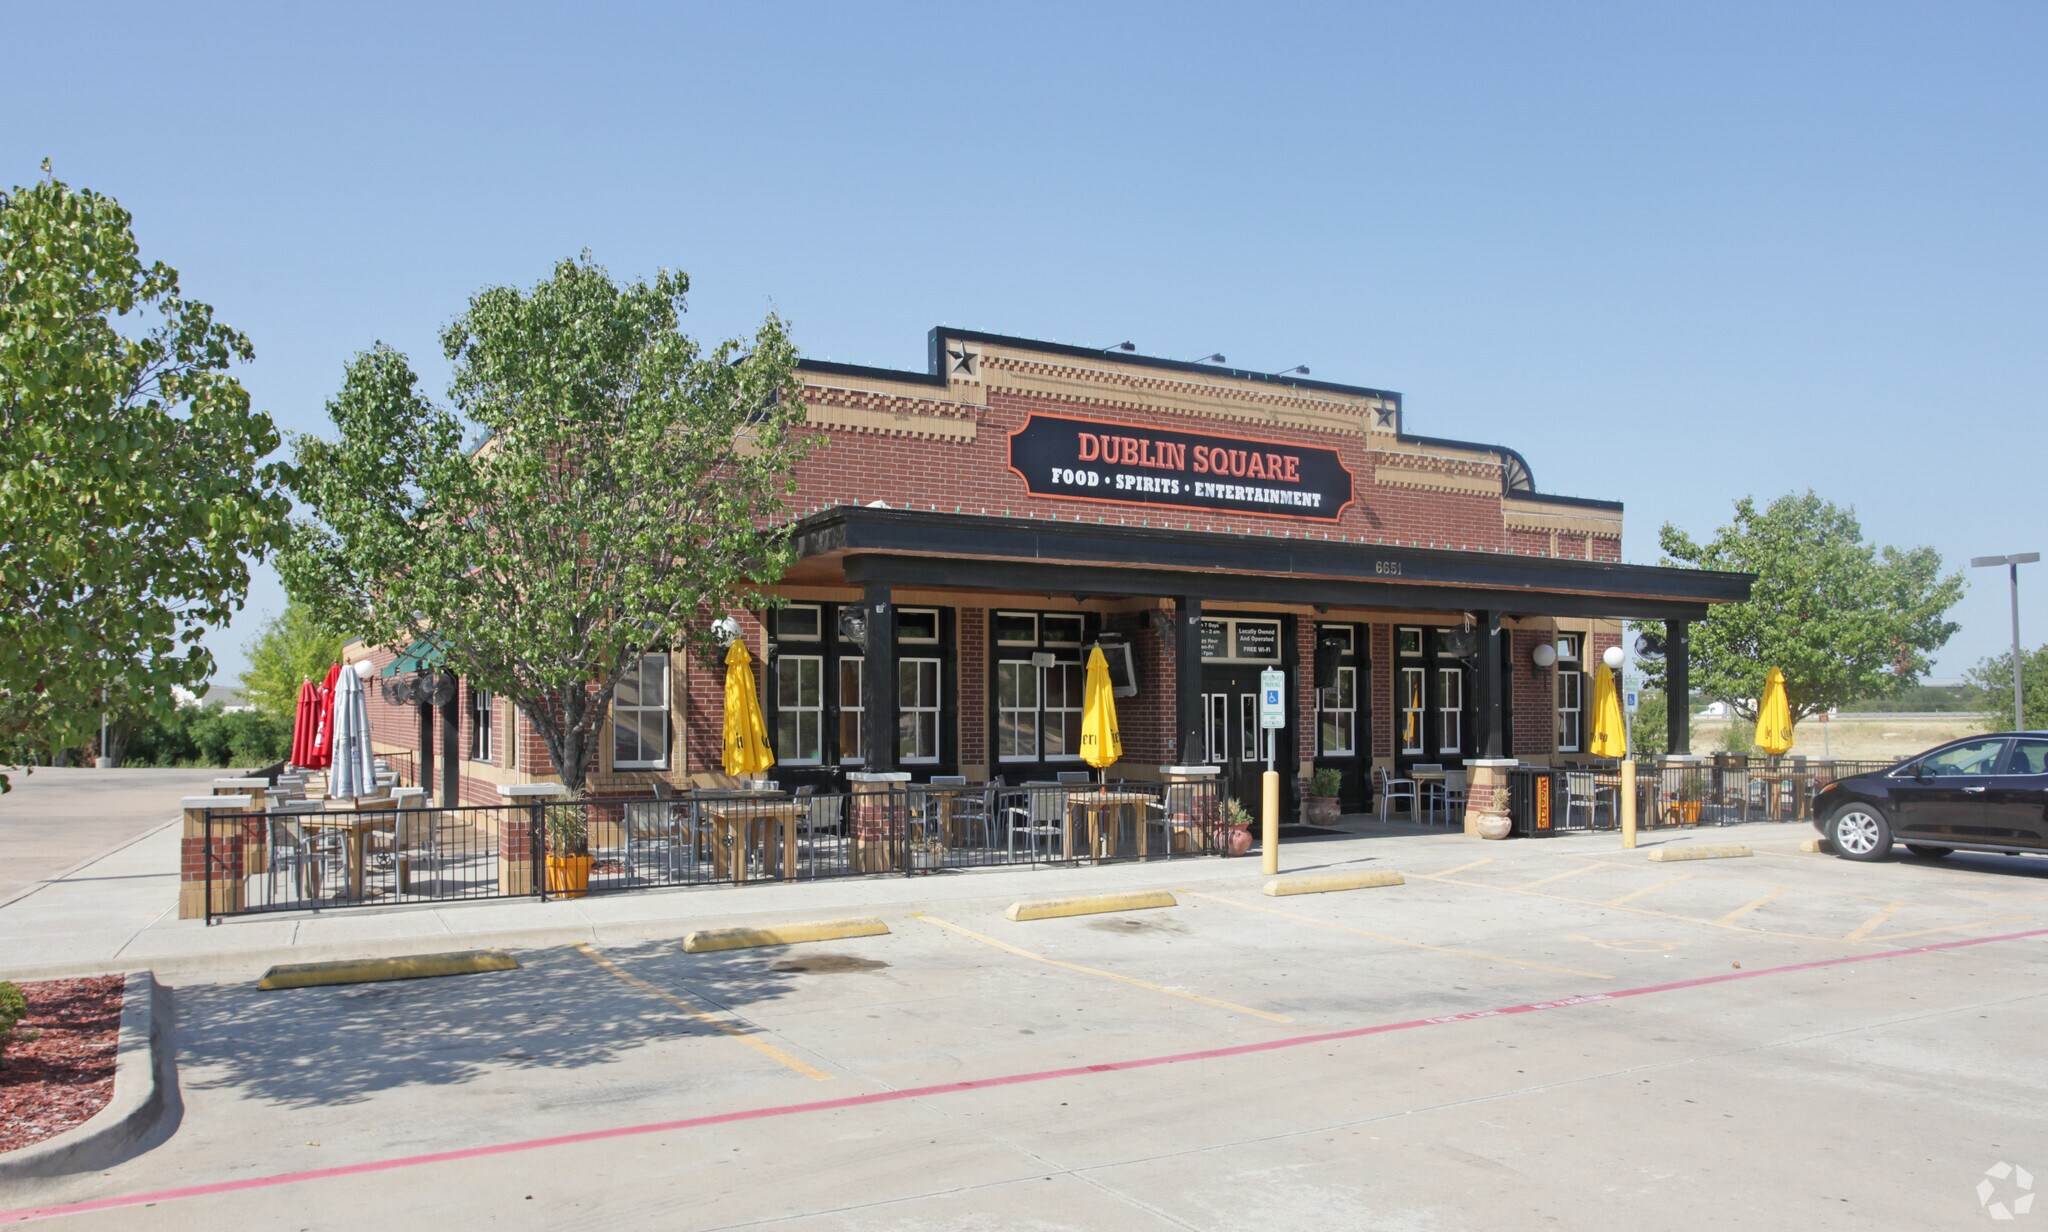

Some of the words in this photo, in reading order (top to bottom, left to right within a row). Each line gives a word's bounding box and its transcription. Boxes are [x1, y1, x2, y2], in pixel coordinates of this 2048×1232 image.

[1077, 432, 1186, 471] DUBLIN
[1193, 445, 1300, 483] SQUARE
[1051, 467, 1099, 487] FOOD
[1115, 473, 1180, 495] SPIRITS
[1194, 481, 1321, 508] ENTERTAINMENT
[1375, 561, 1402, 575] 6651
[1239, 628, 1257, 636] Locally
